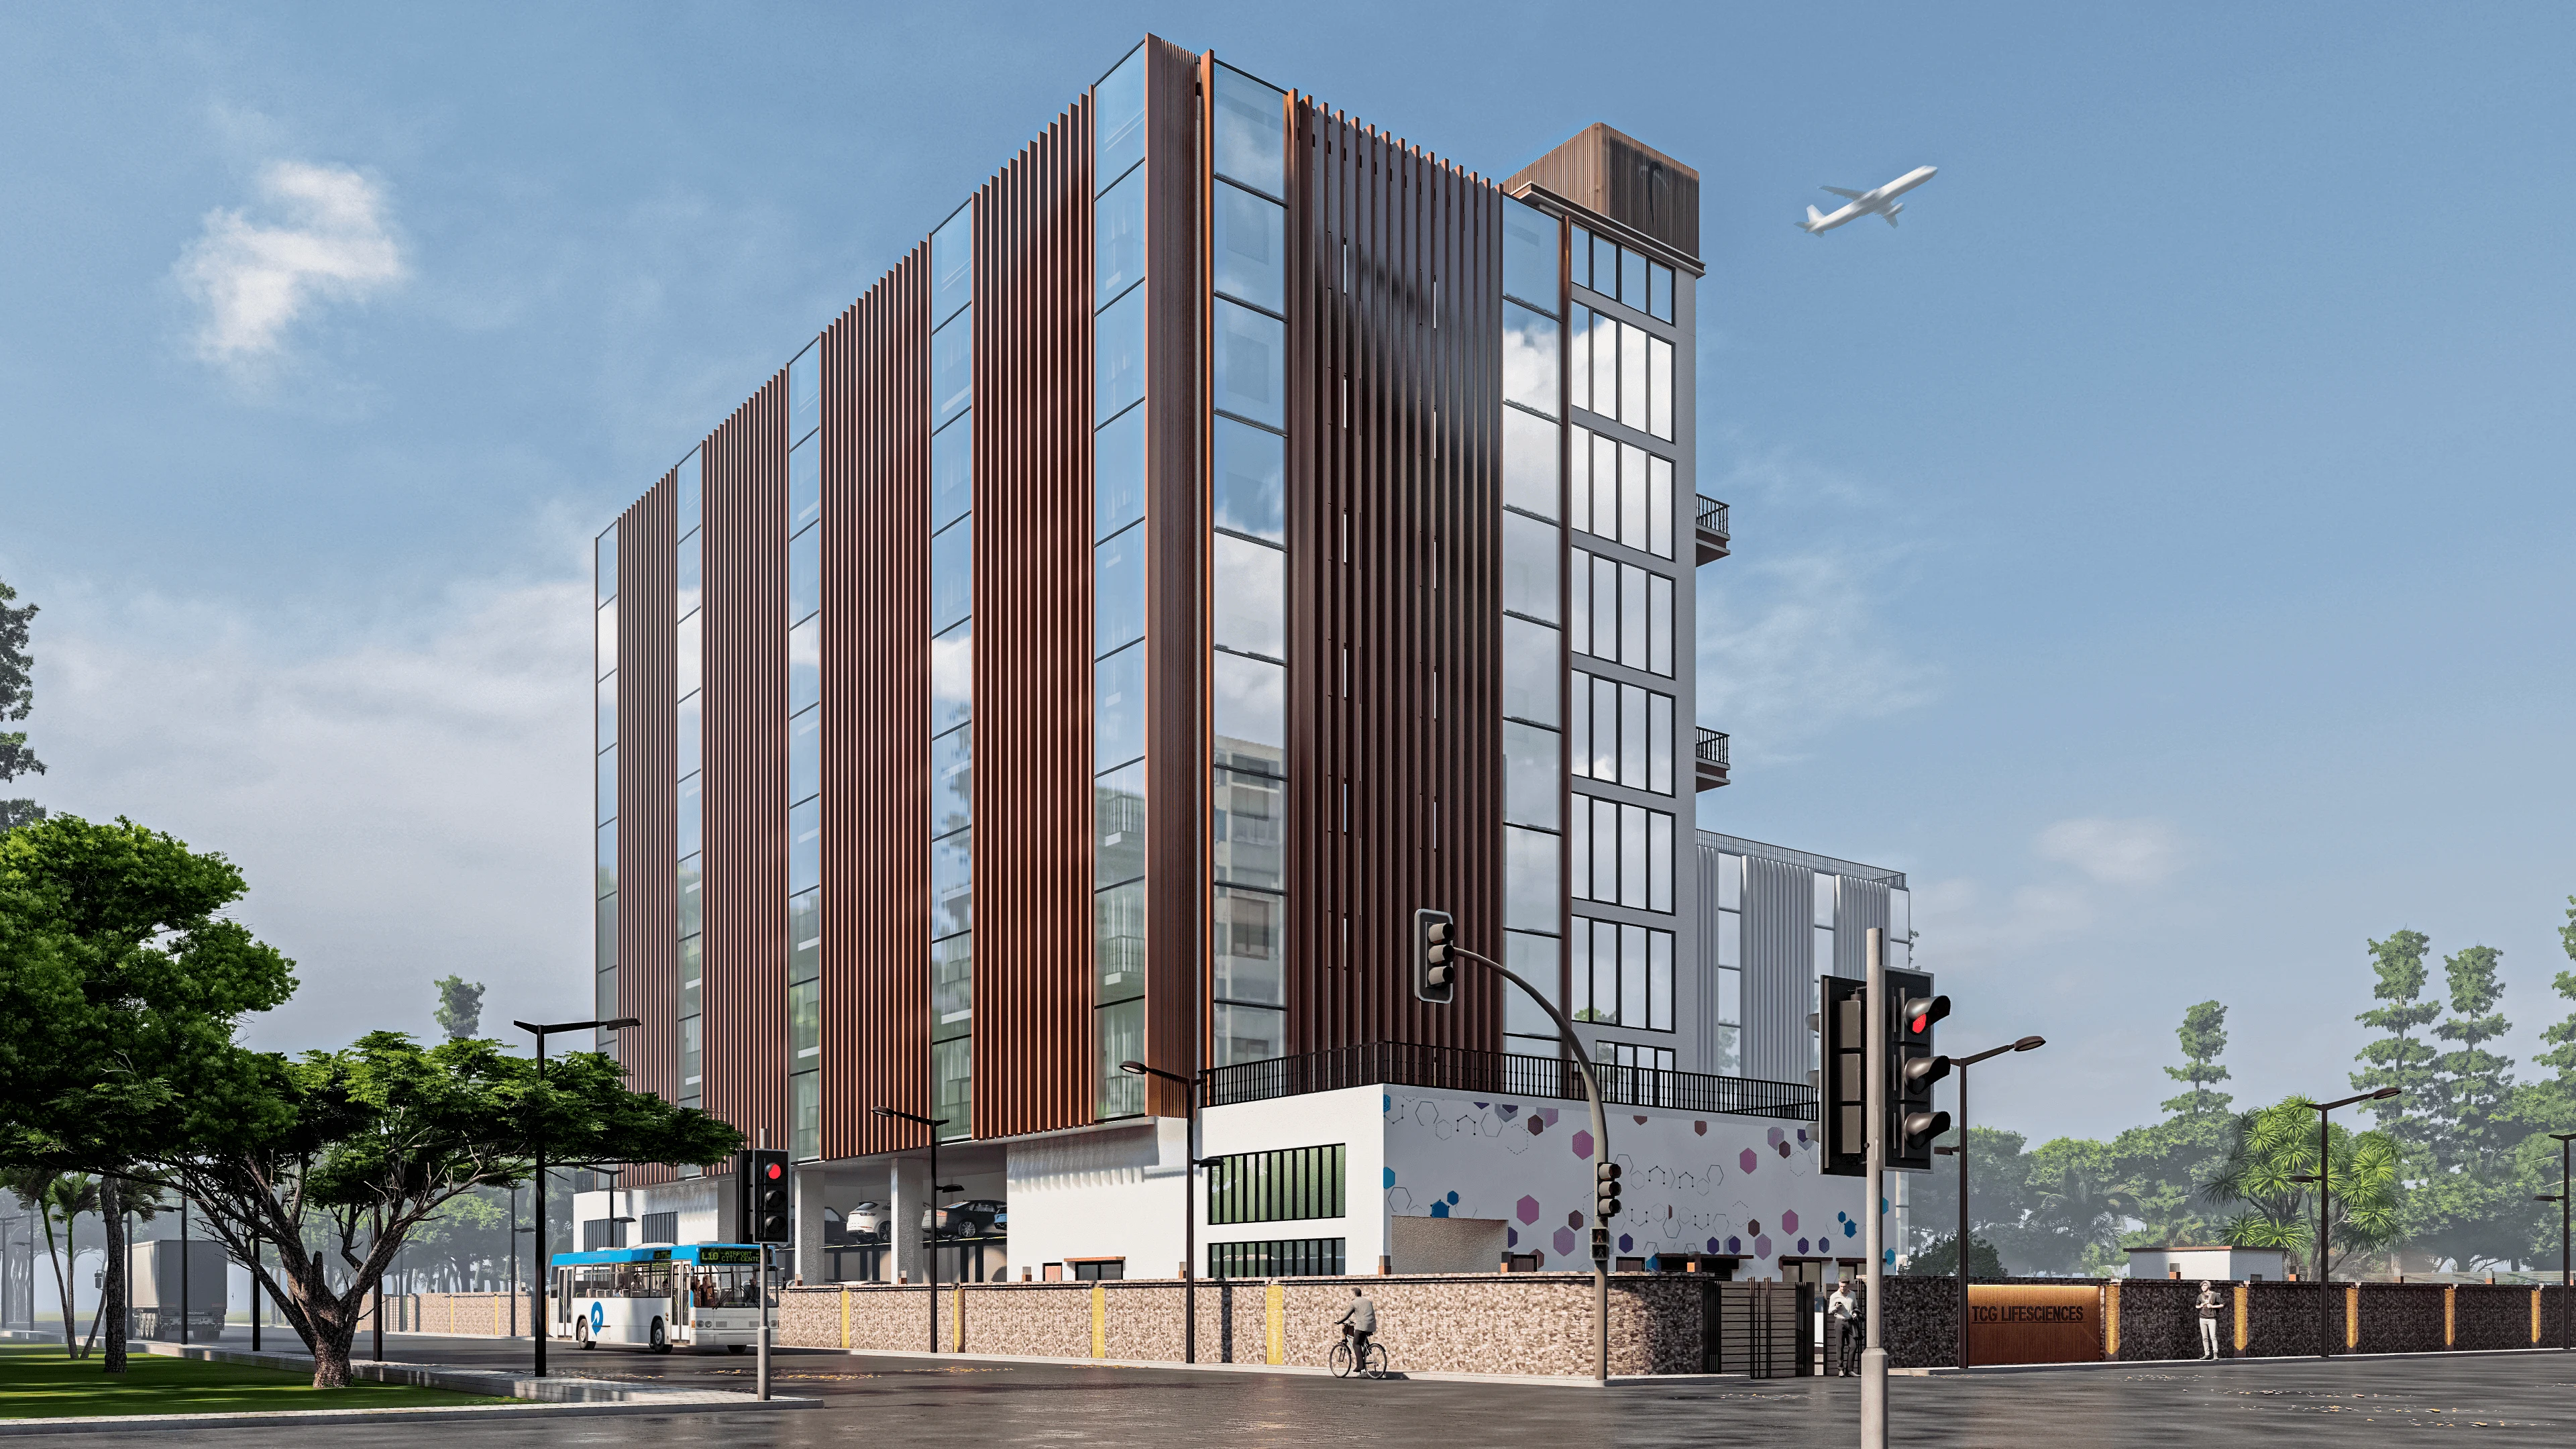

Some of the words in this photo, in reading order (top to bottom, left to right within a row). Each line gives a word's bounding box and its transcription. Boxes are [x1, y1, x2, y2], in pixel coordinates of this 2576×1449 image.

[702, 1252, 718, 1260] L10
[1972, 1306, 1997, 1322] TCG
[2001, 1306, 2084, 1322] LIFESCIENCES
